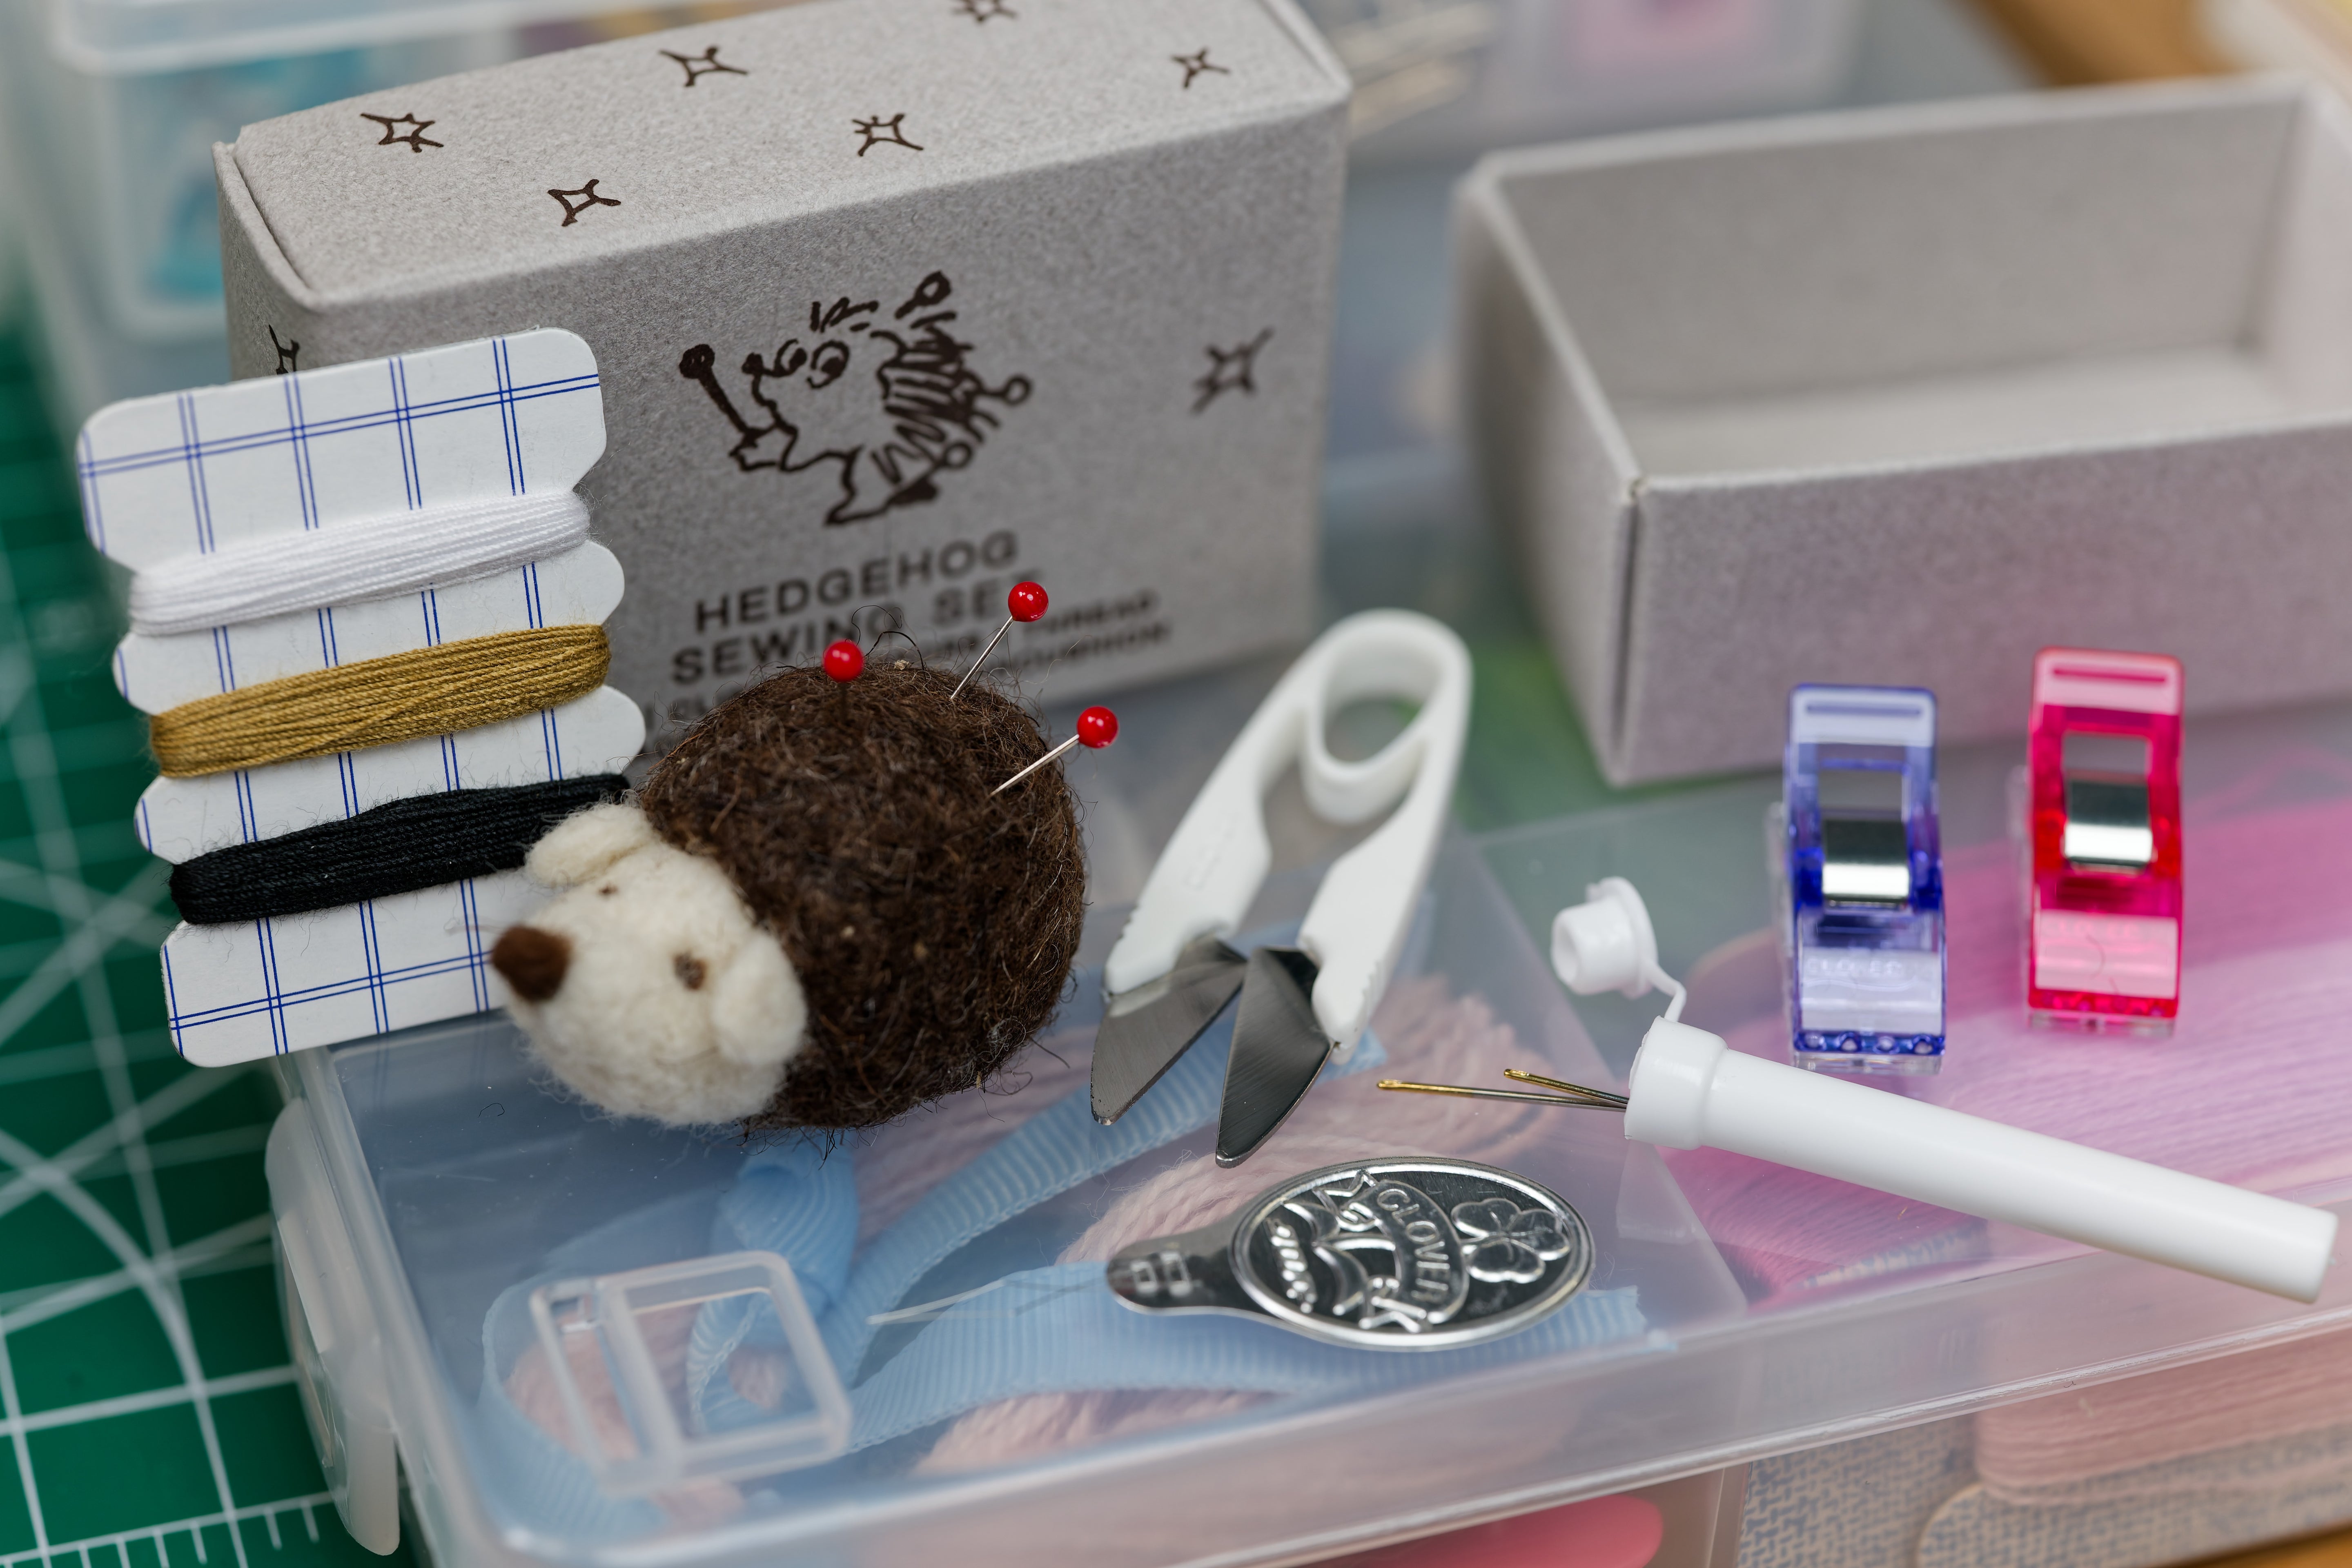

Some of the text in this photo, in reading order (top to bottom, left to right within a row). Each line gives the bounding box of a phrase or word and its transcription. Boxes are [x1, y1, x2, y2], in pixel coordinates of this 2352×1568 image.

[673, 602, 904, 685] SEWING
[933, 570, 1045, 626] SE
[695, 529, 1018, 633] HEDGEHOG
[1376, 1188, 1451, 1304] CLOVER
